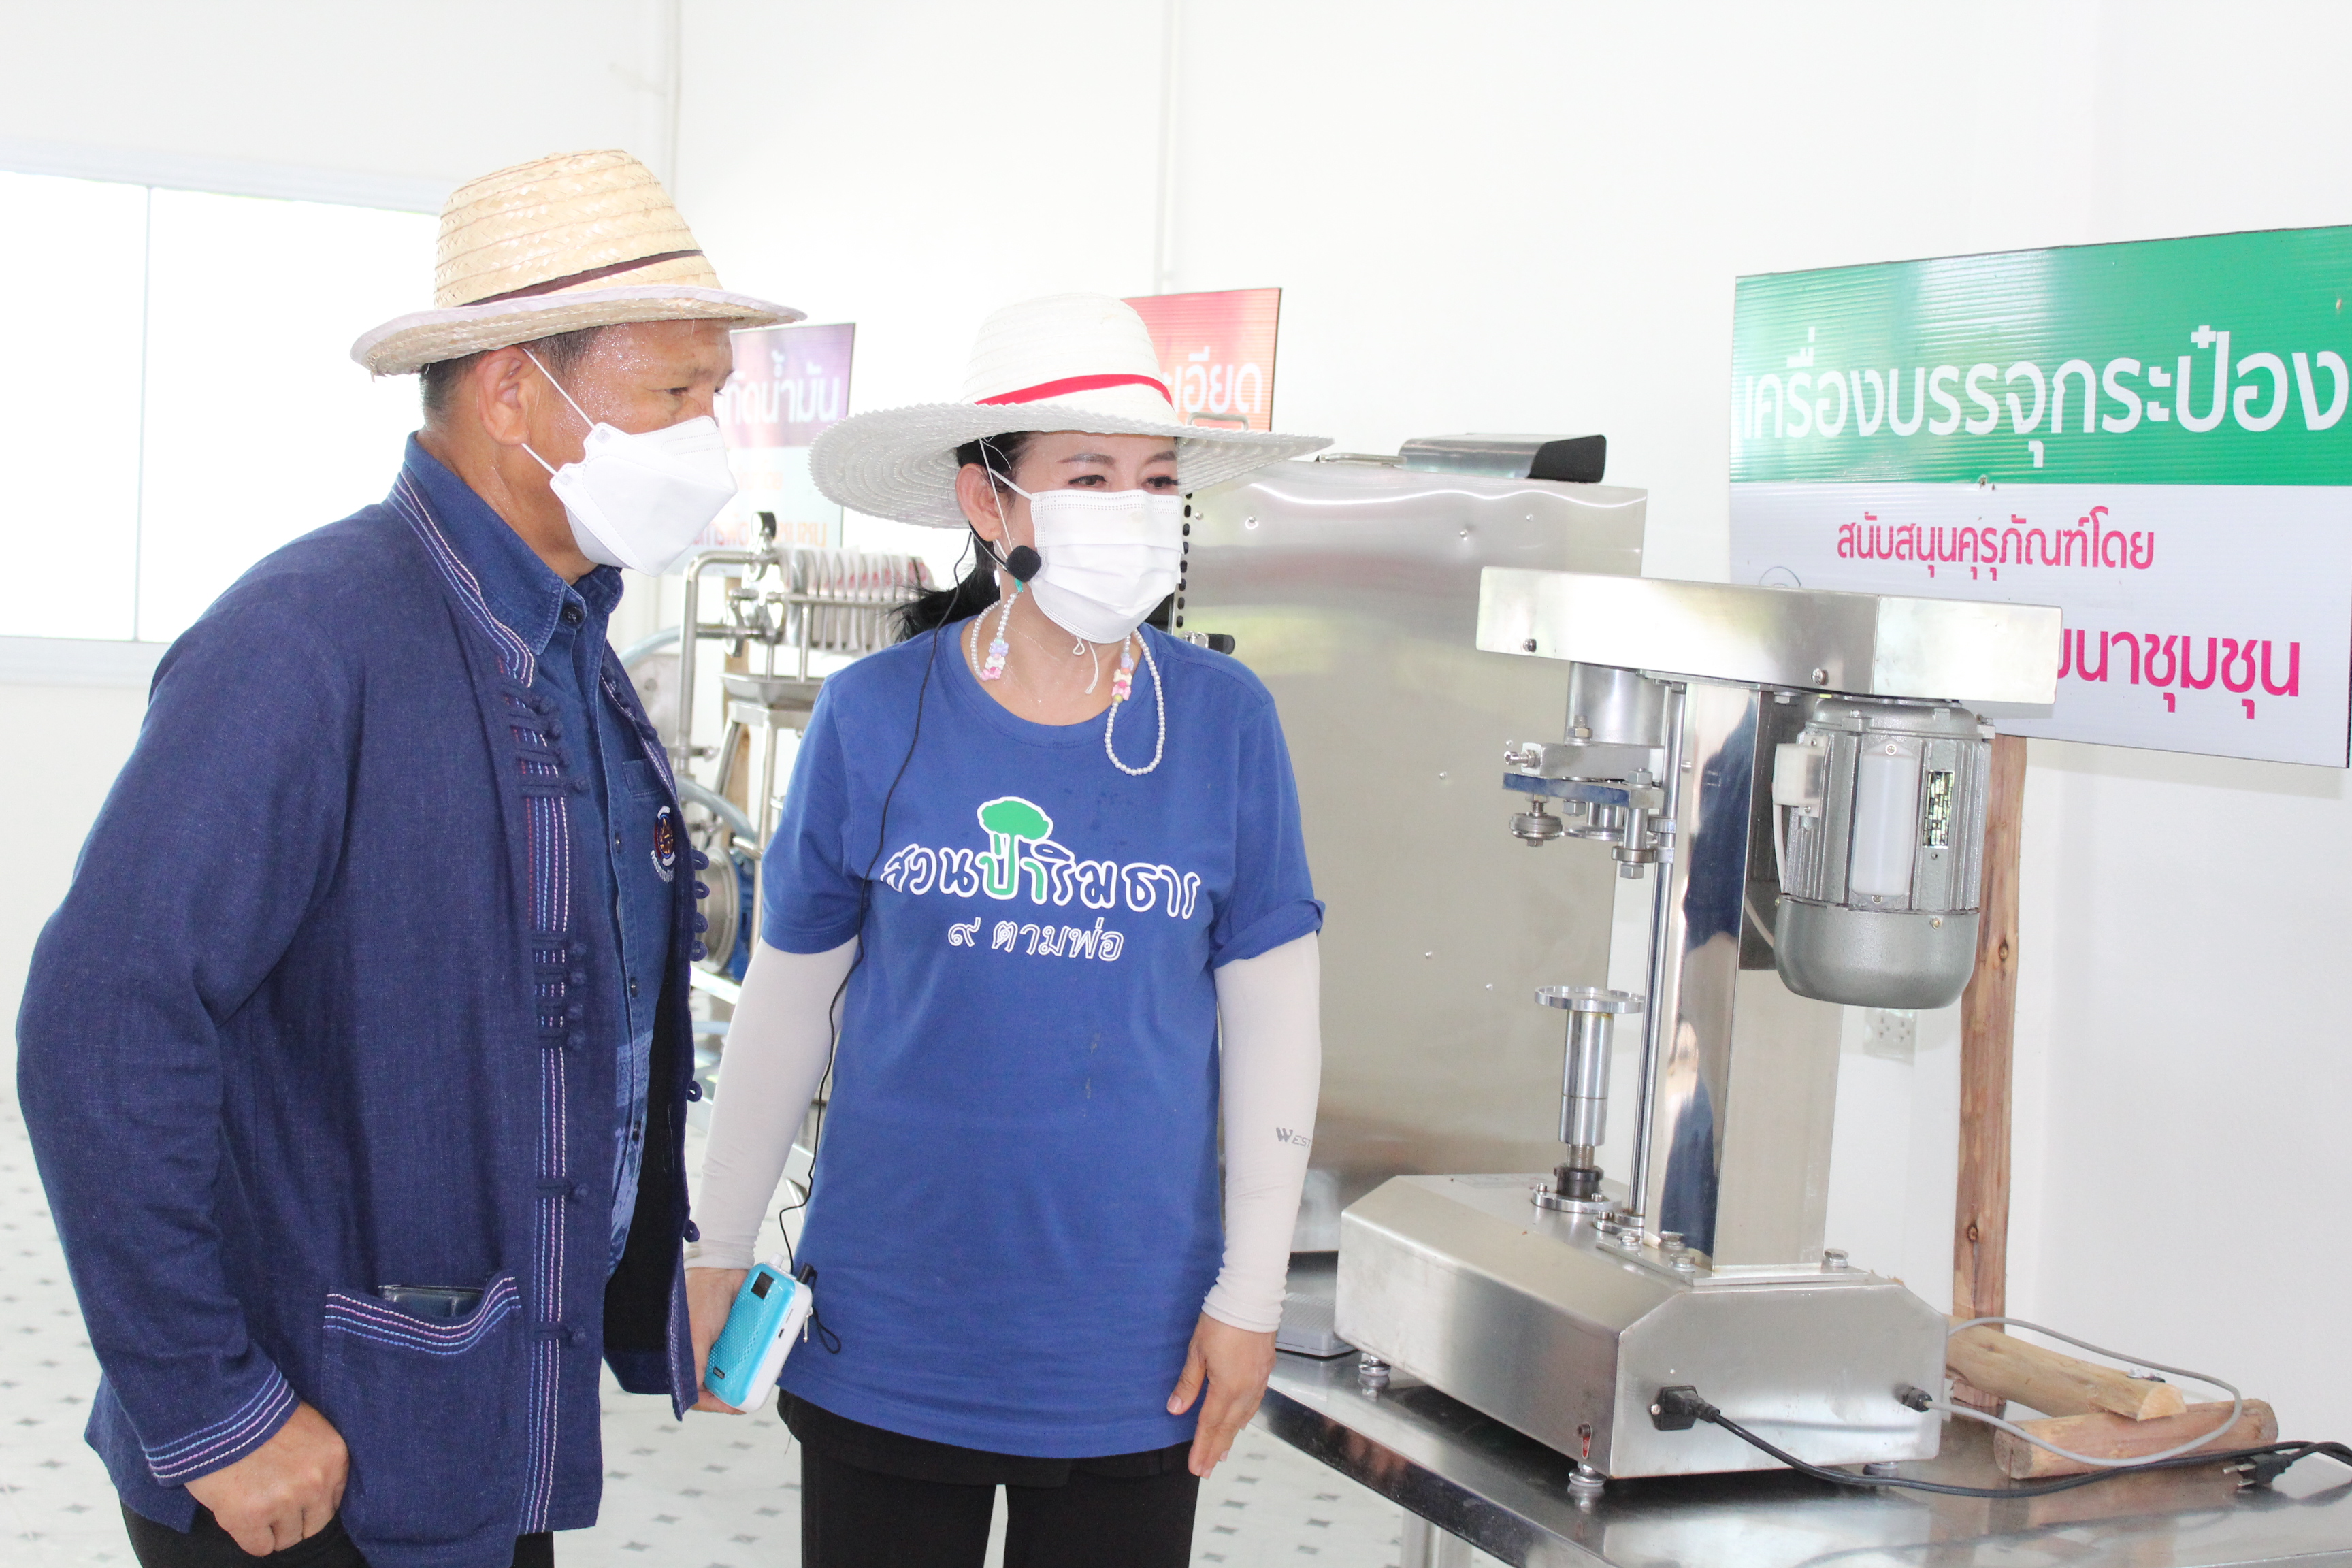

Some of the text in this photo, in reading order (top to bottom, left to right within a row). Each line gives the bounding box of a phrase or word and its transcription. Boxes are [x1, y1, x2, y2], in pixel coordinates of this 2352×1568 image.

[1744, 325, 2350, 468] เครื่องบรรจุกระป๋อง
[1837, 505, 2155, 581] สนับสนุนคุรุภัณฑ์โดย
[991, 917, 1124, 962] ตามพ่อ
